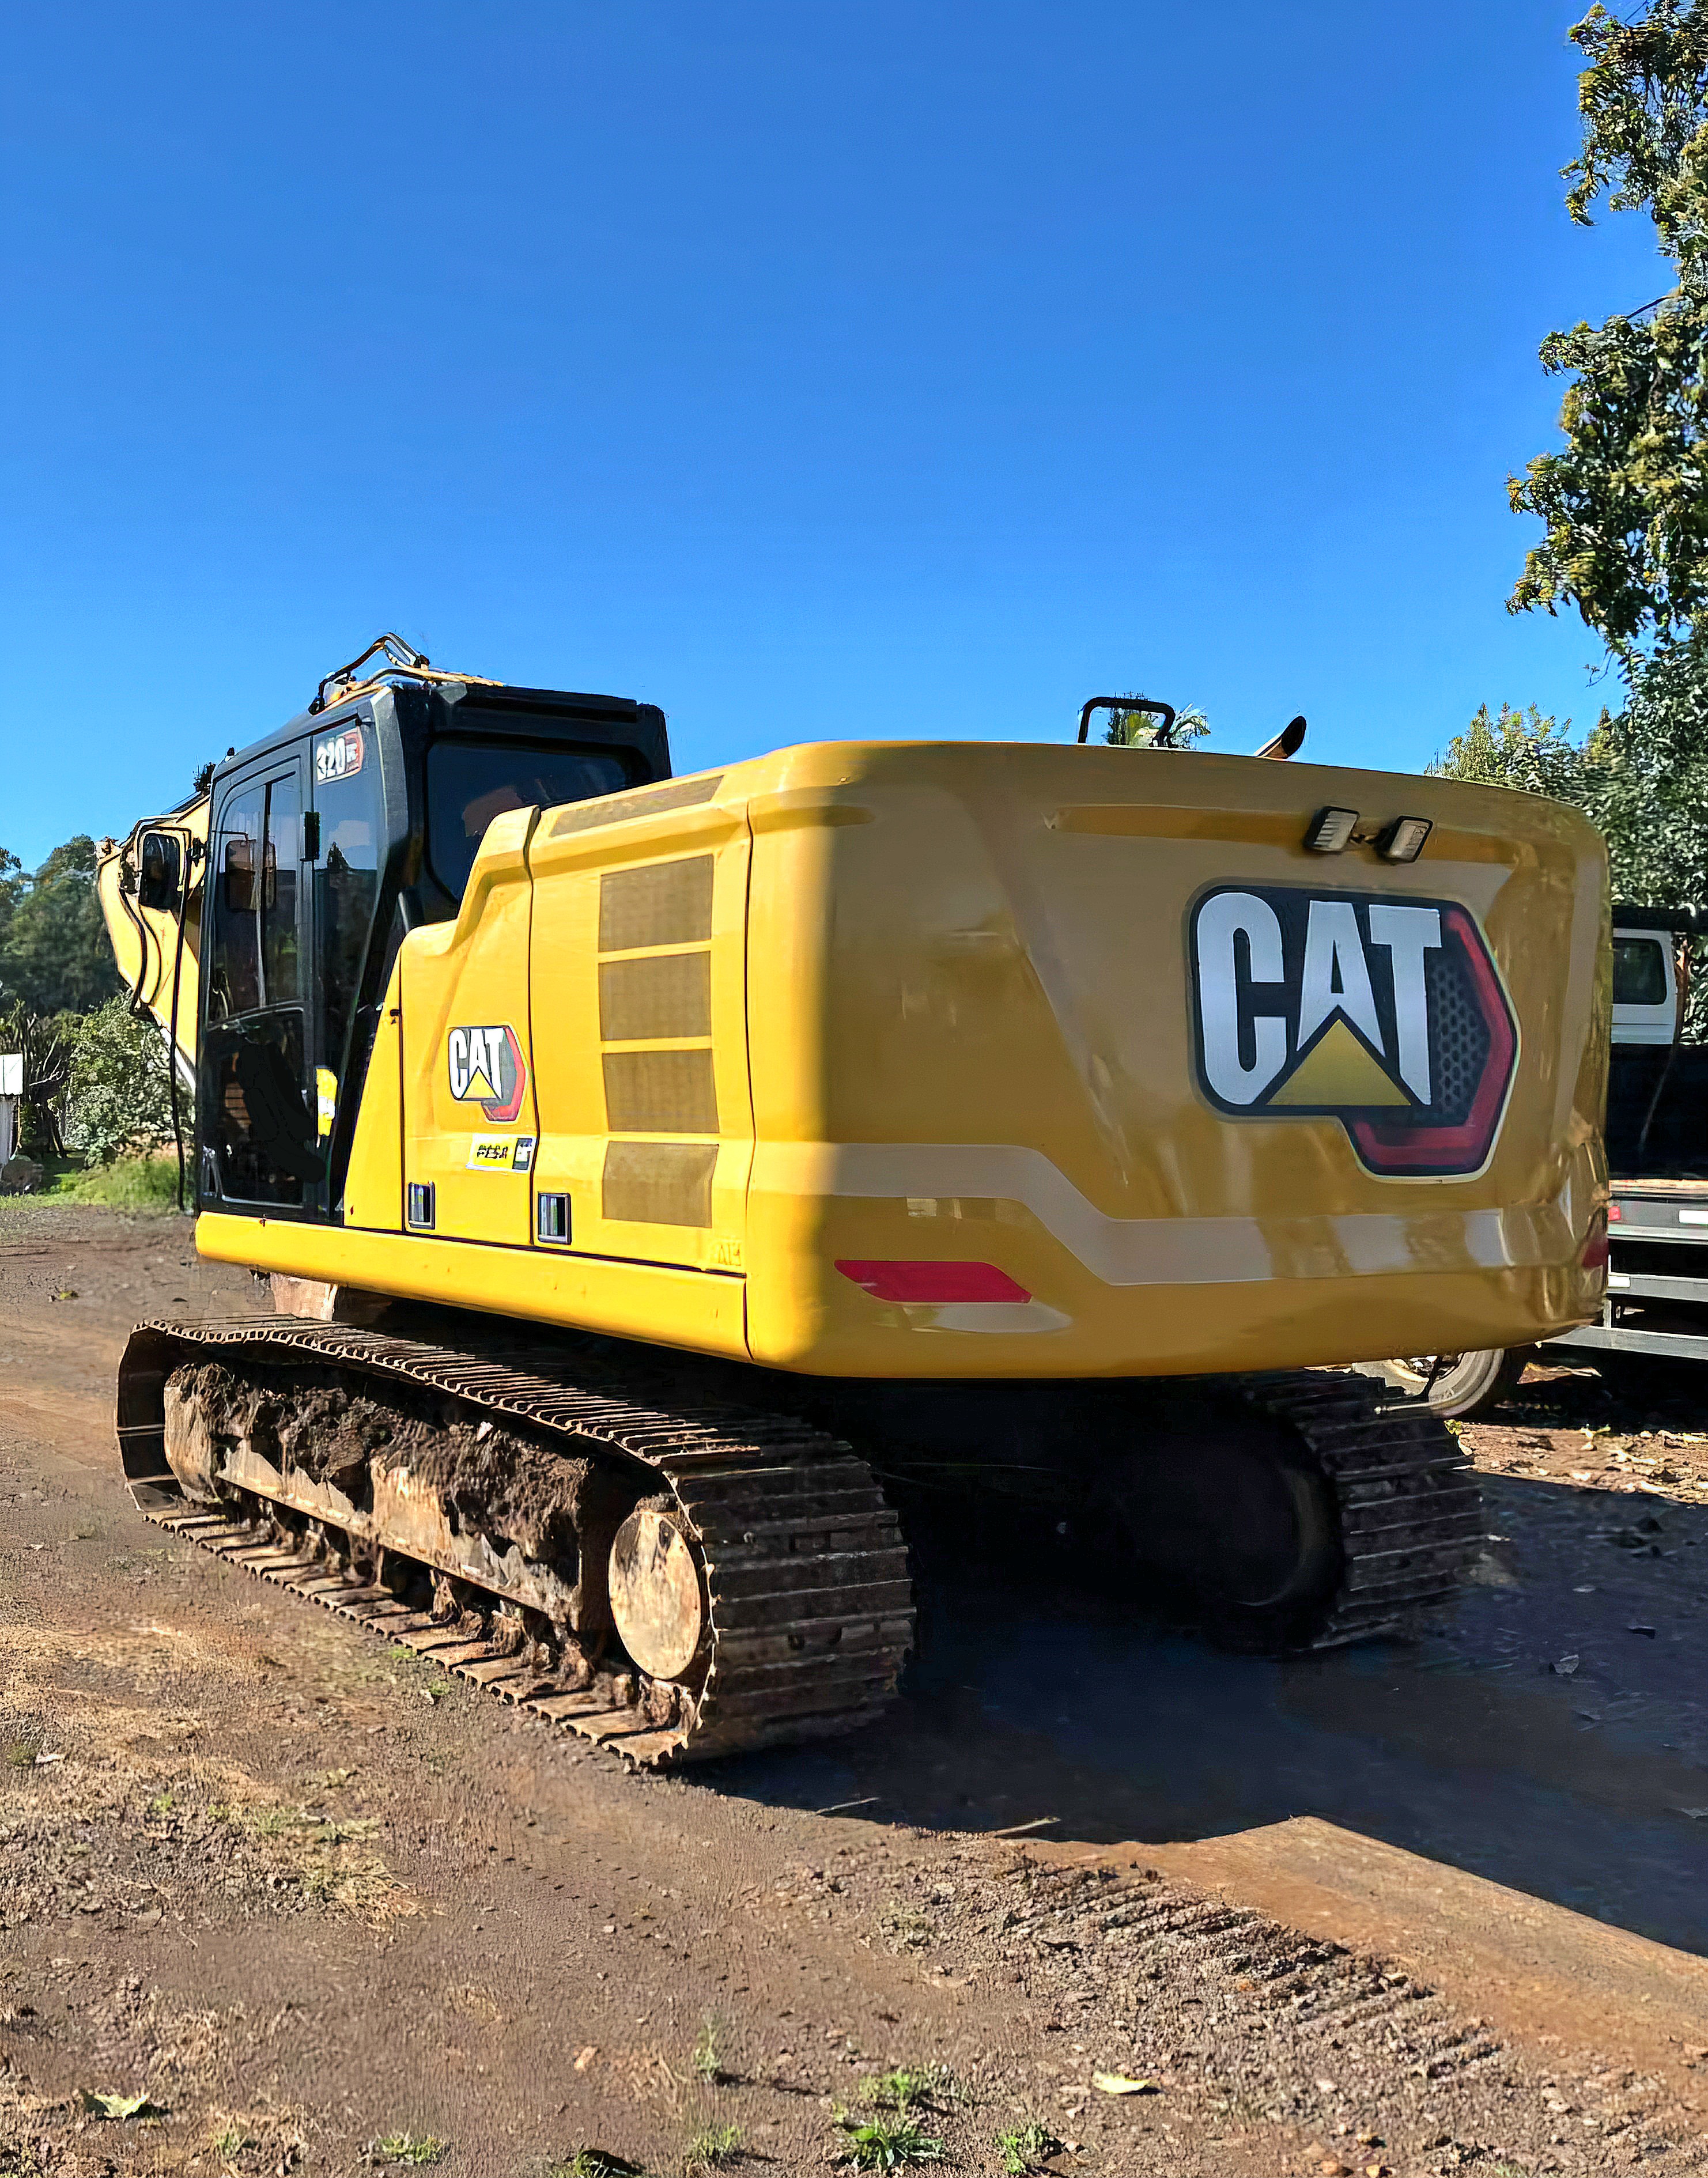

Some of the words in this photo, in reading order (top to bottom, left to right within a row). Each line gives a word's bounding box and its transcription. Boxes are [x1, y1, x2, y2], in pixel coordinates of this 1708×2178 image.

[316, 738, 346, 781] 320
[1197, 893, 1442, 1105] CAT
[449, 1028, 504, 1099] CAT
